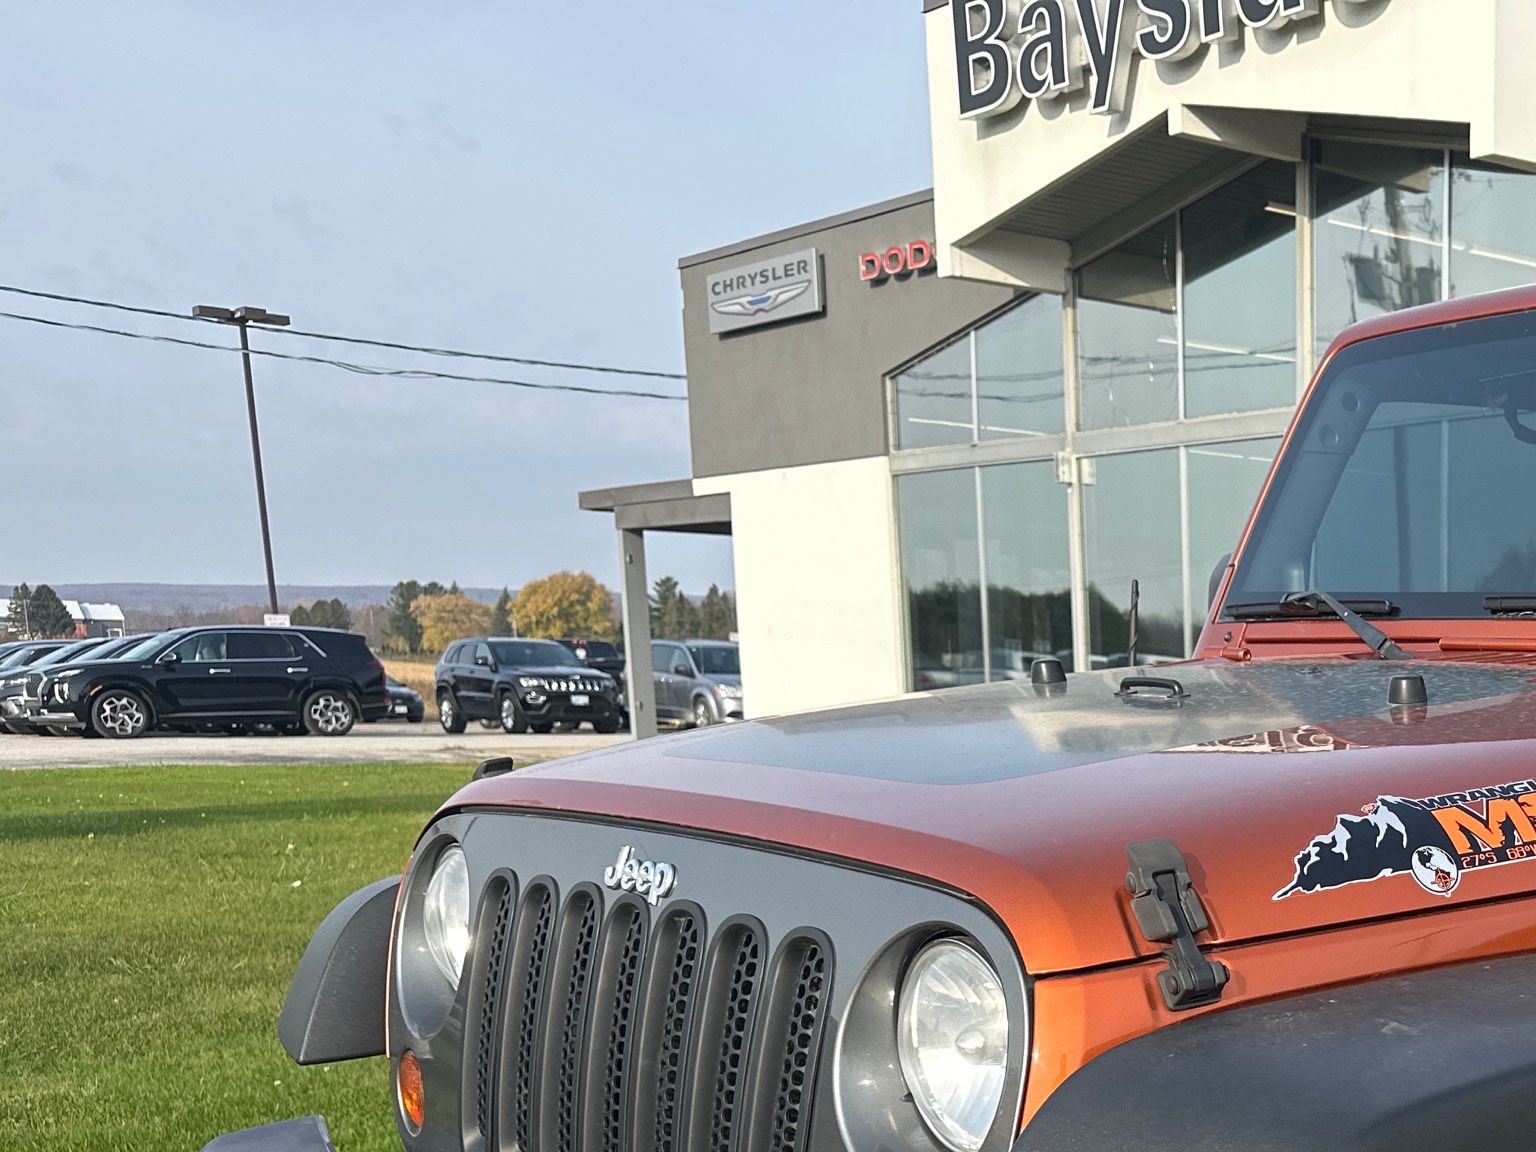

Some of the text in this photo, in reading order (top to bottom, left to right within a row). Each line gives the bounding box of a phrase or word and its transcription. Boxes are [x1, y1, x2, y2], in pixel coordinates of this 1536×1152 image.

[711, 259, 811, 296] CHRYSLER
[858, 240, 937, 281] DOD
[604, 845, 677, 906] Jeep
